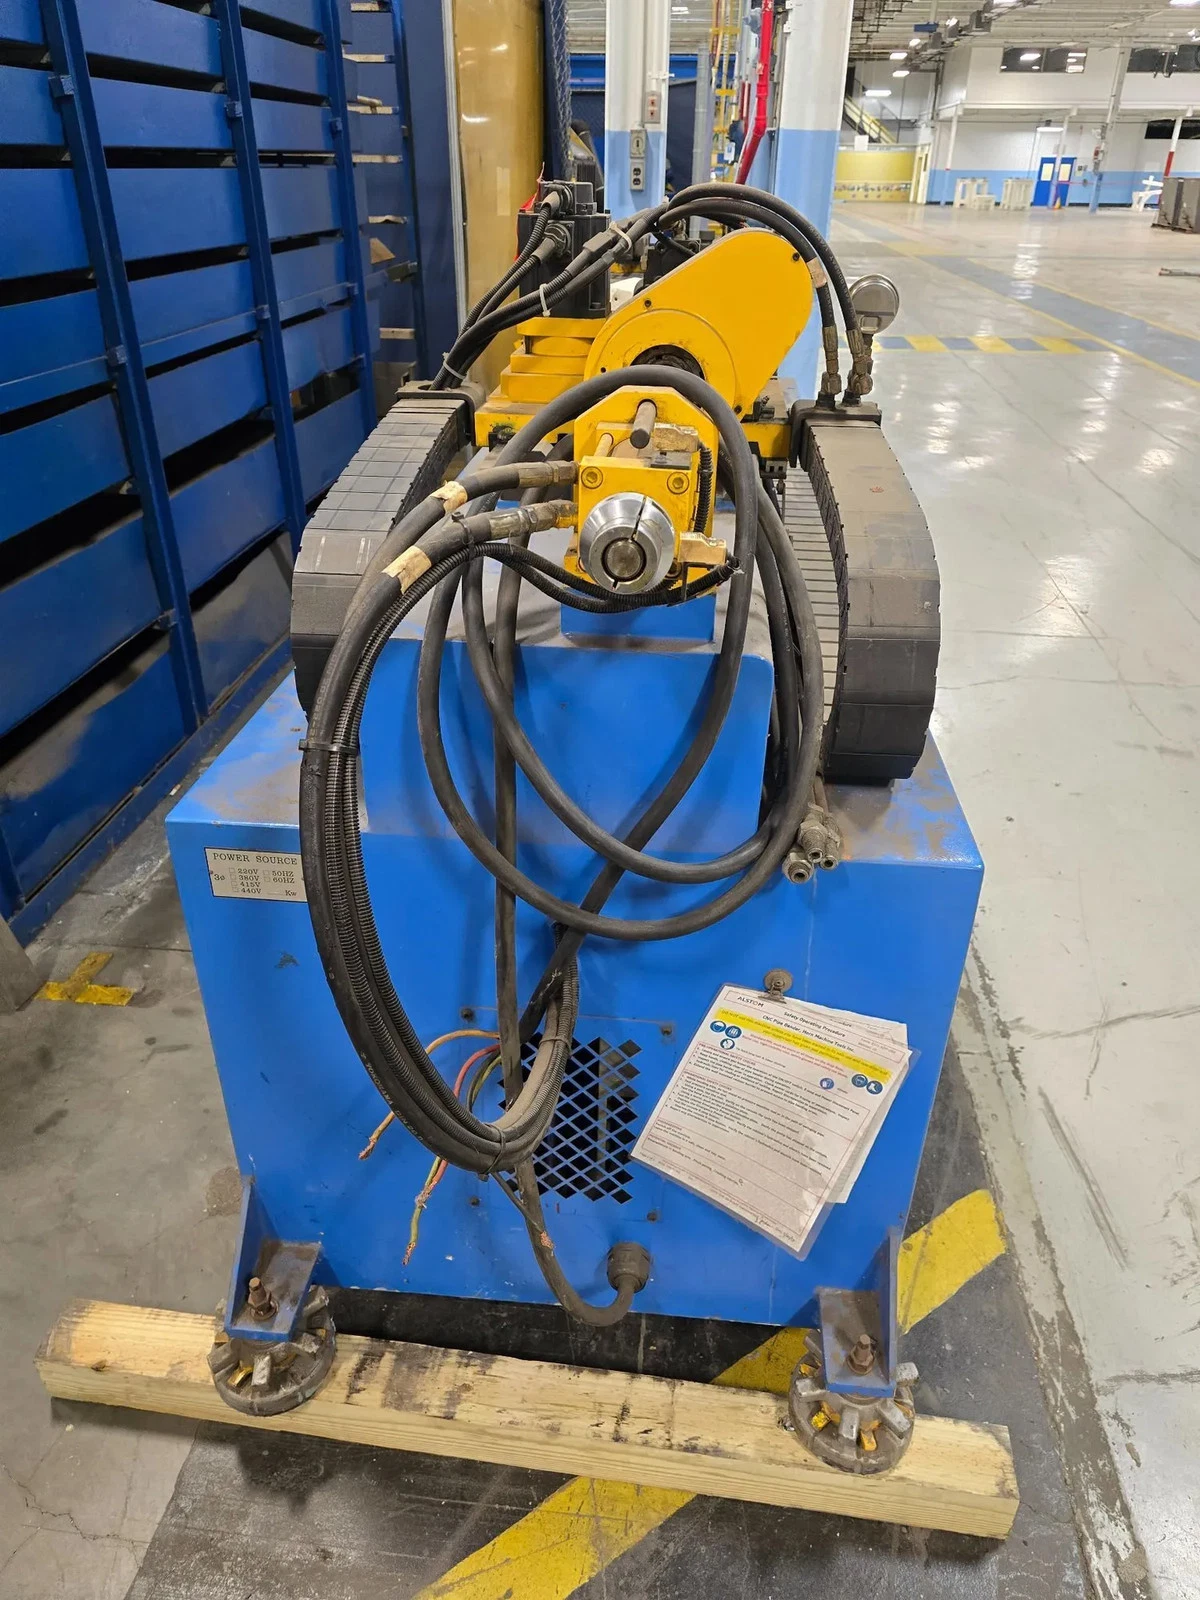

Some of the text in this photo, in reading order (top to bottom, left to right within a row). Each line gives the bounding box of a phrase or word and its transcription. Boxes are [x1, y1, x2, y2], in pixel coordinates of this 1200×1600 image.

[213, 852, 298, 865] POWER SOURCE
[238, 874, 260, 882] 380V
[271, 870, 294, 878] 50HZ
[737, 995, 765, 1009] ALSTOM
[783, 1012, 800, 1021] Safety
[798, 1018, 823, 1030] Operating
[821, 1026, 847, 1038] Procedure
[814, 1034, 835, 1044] Machine
[834, 1041, 847, 1049] Tools
